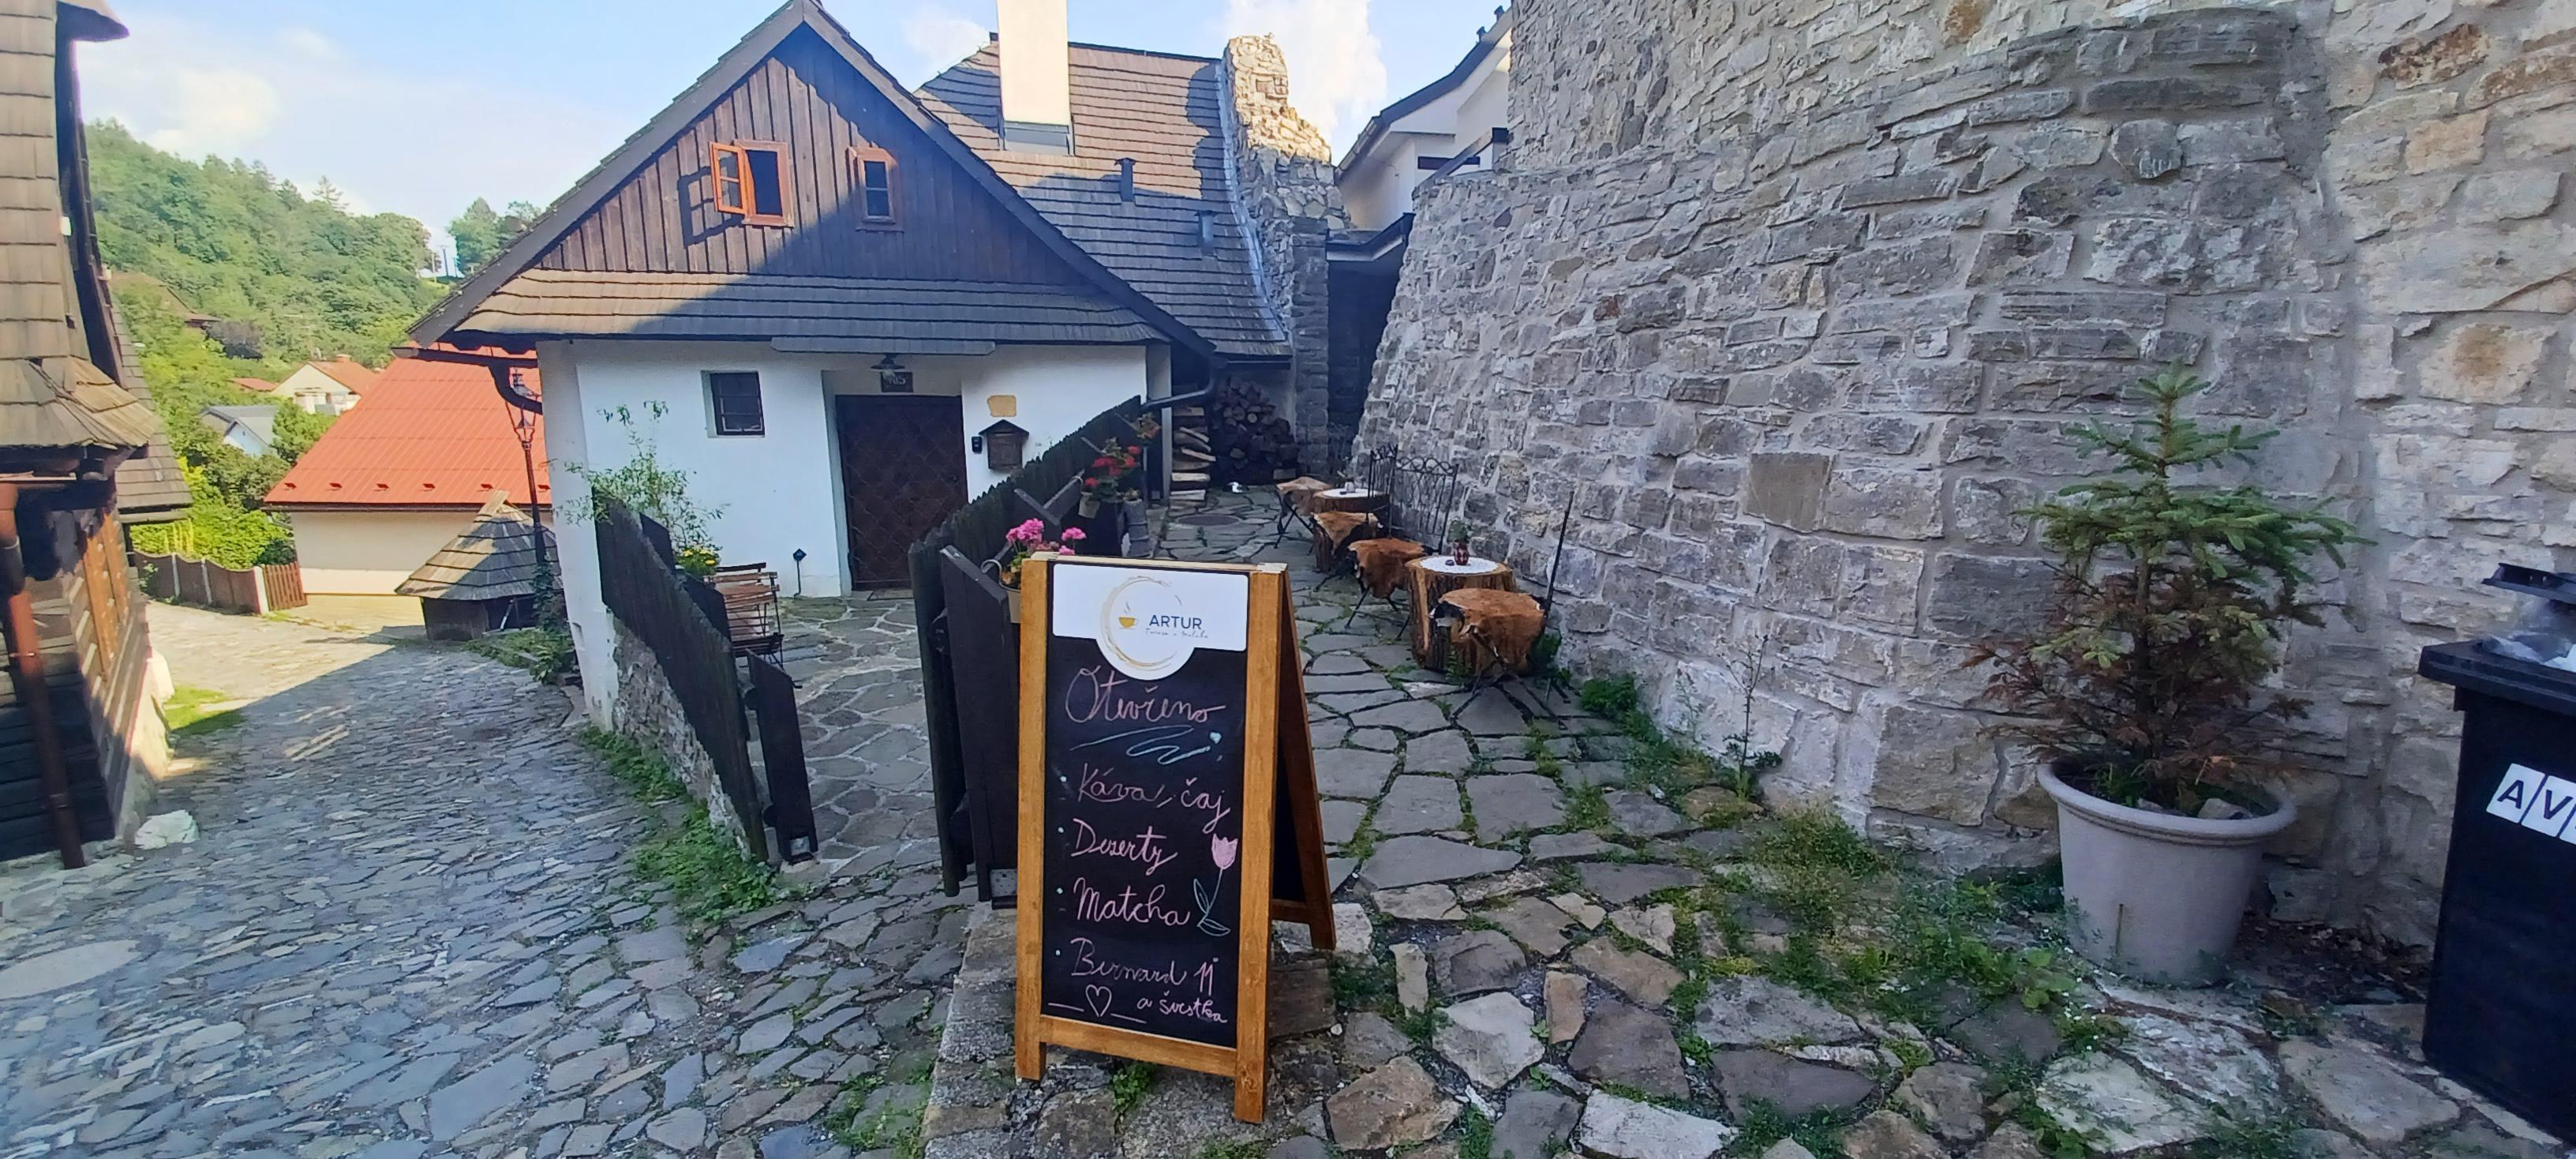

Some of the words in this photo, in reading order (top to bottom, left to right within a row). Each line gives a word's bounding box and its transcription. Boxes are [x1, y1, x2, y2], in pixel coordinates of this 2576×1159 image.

[1149, 614, 1203, 630] ARTUR
[1065, 664, 1226, 723] Otevřeno
[1181, 777, 1231, 834] čaj
[2497, 779, 2576, 829] AV
[1070, 817, 1178, 876] Dezerty
[1073, 876, 1190, 927] Matcha
[1070, 937, 1188, 986] Bernard
[1136, 996, 1152, 1010] a
[1159, 990, 1229, 1024] švestka
